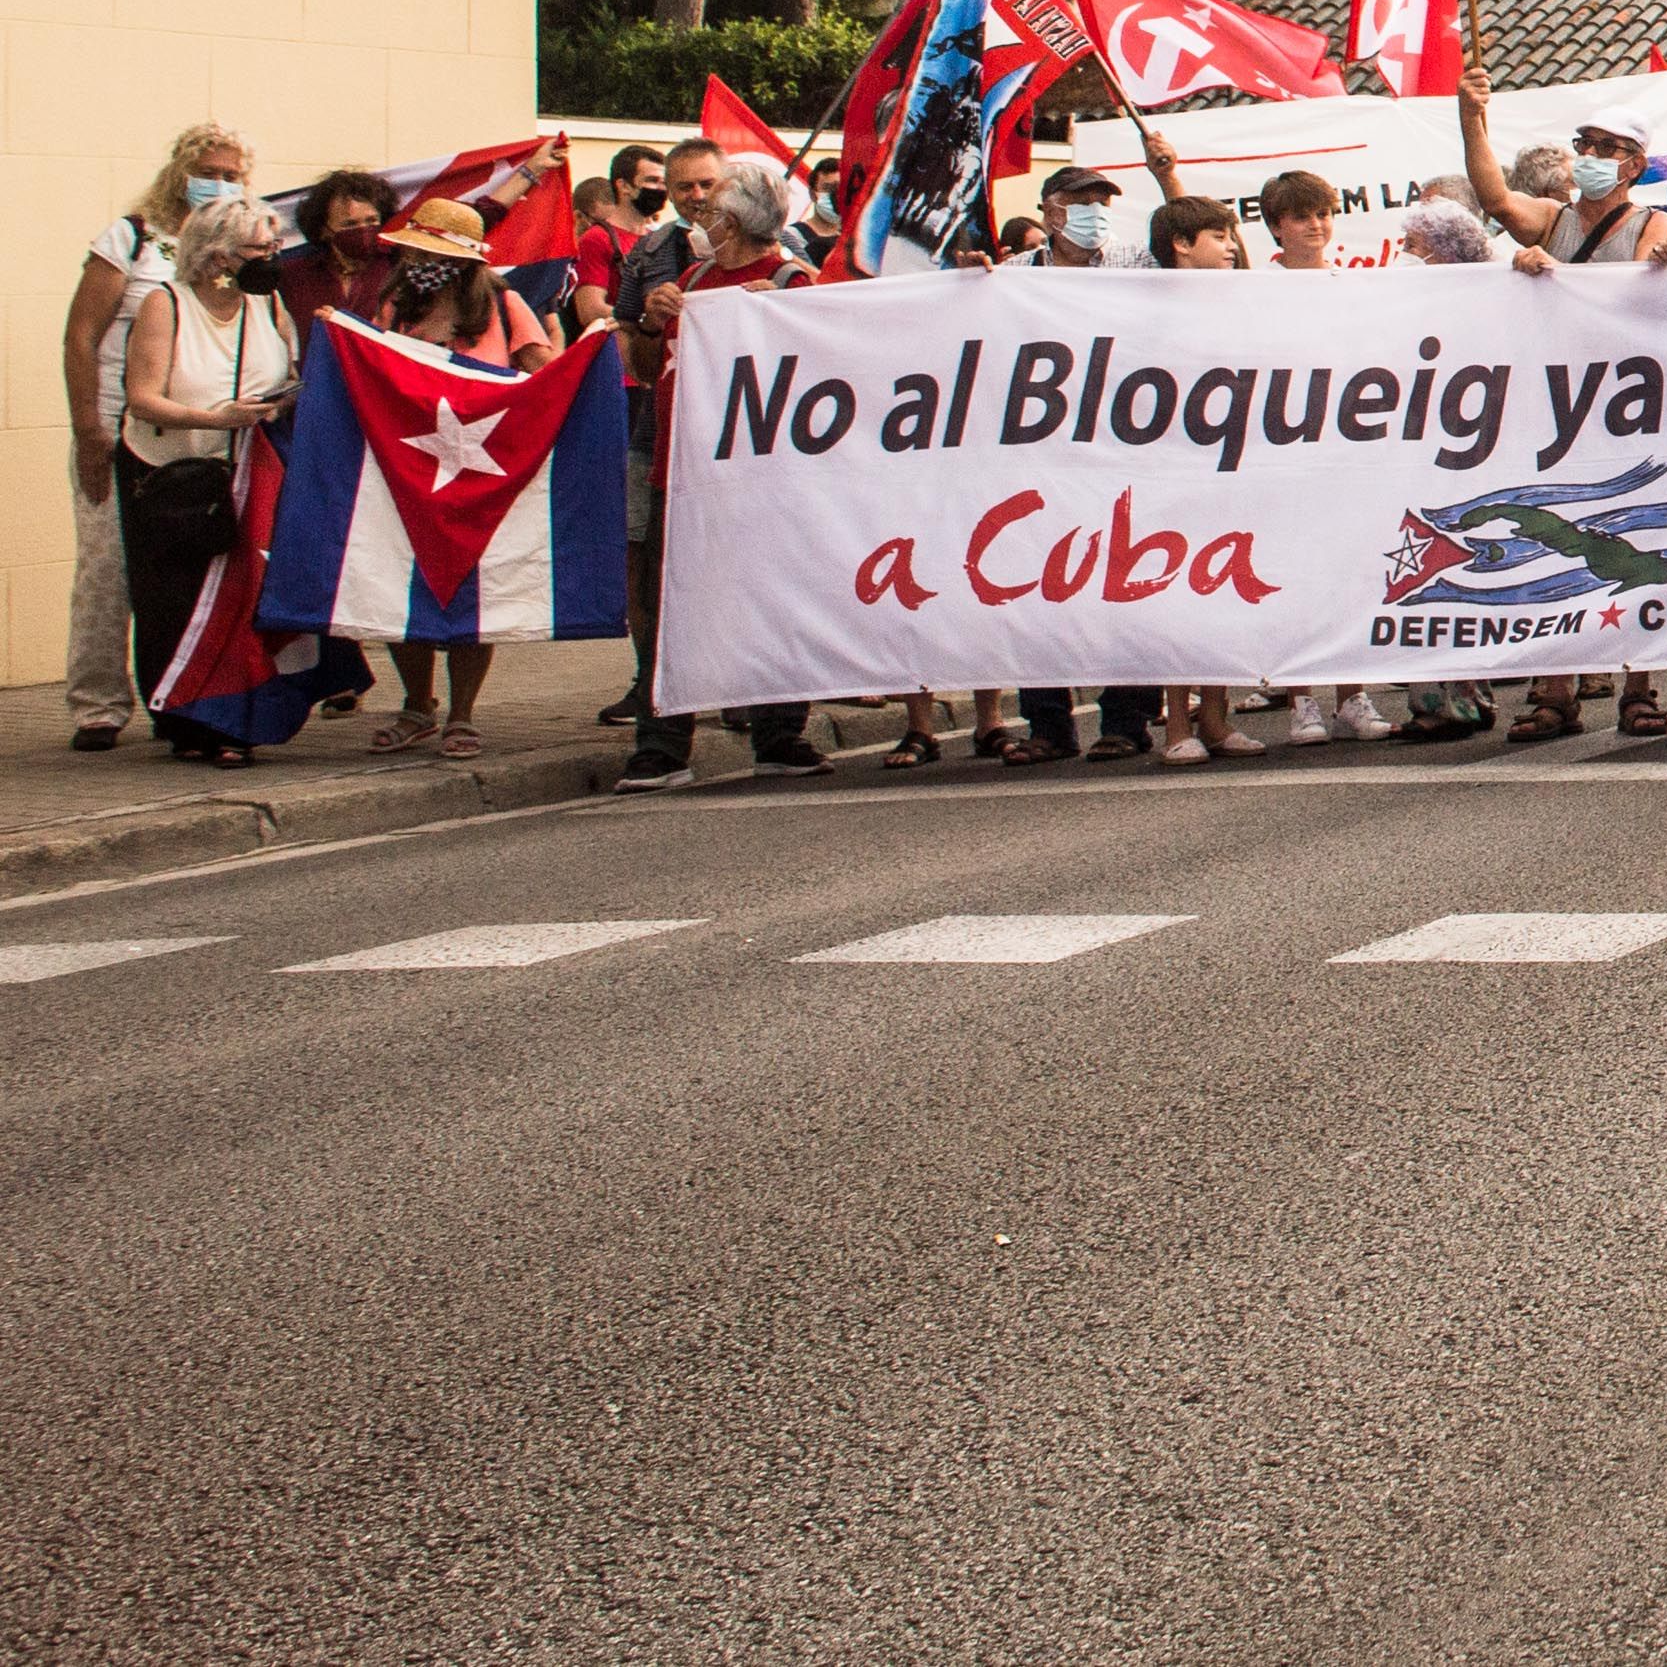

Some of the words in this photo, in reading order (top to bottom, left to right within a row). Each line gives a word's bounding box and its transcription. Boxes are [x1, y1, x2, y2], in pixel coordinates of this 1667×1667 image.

[714, 354, 857, 461] No
[882, 339, 983, 453] al
[999, 335, 1512, 472] Bloqueig
[855, 537, 938, 611] a
[963, 484, 1283, 606] Cuba
[1370, 608, 1588, 648] DEFENSEM
